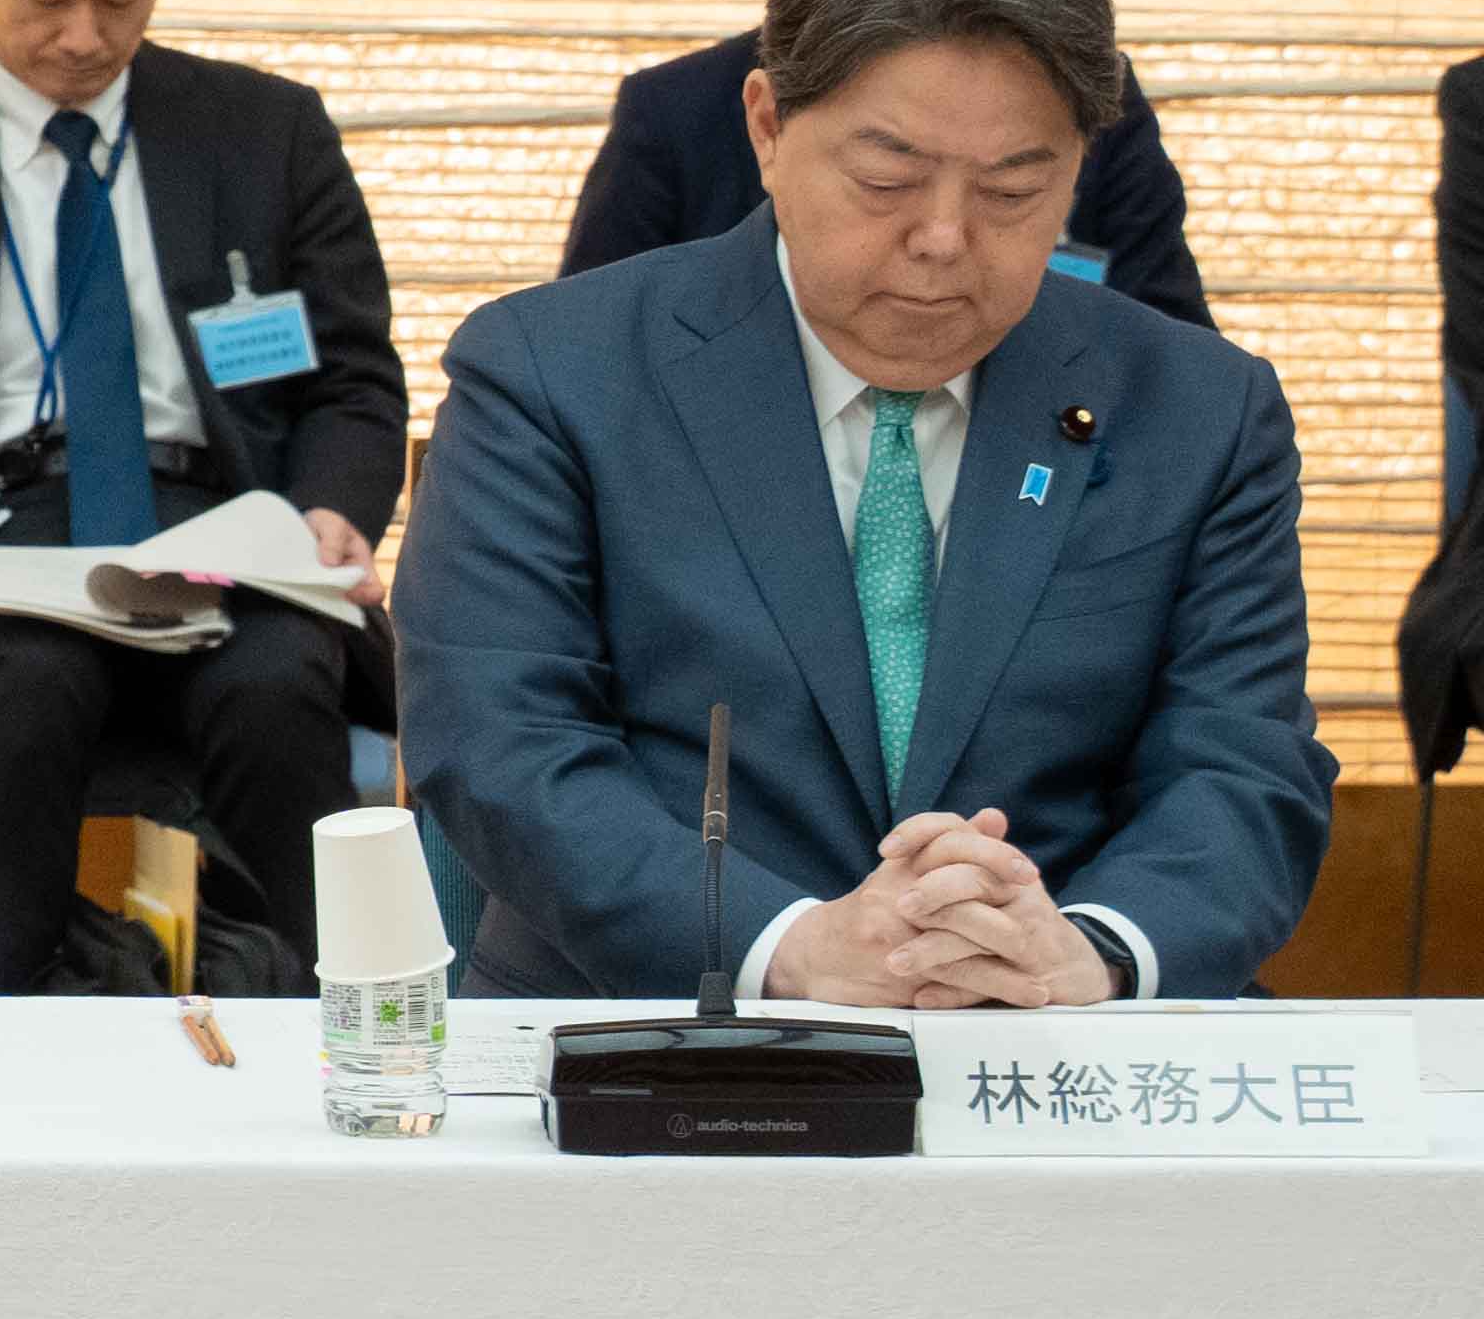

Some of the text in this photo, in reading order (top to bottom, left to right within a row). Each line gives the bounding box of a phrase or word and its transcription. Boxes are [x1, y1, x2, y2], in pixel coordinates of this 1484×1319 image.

[967, 1060, 1365, 1125] 林総務大臣
[697, 1119, 808, 1131] audio-technica
